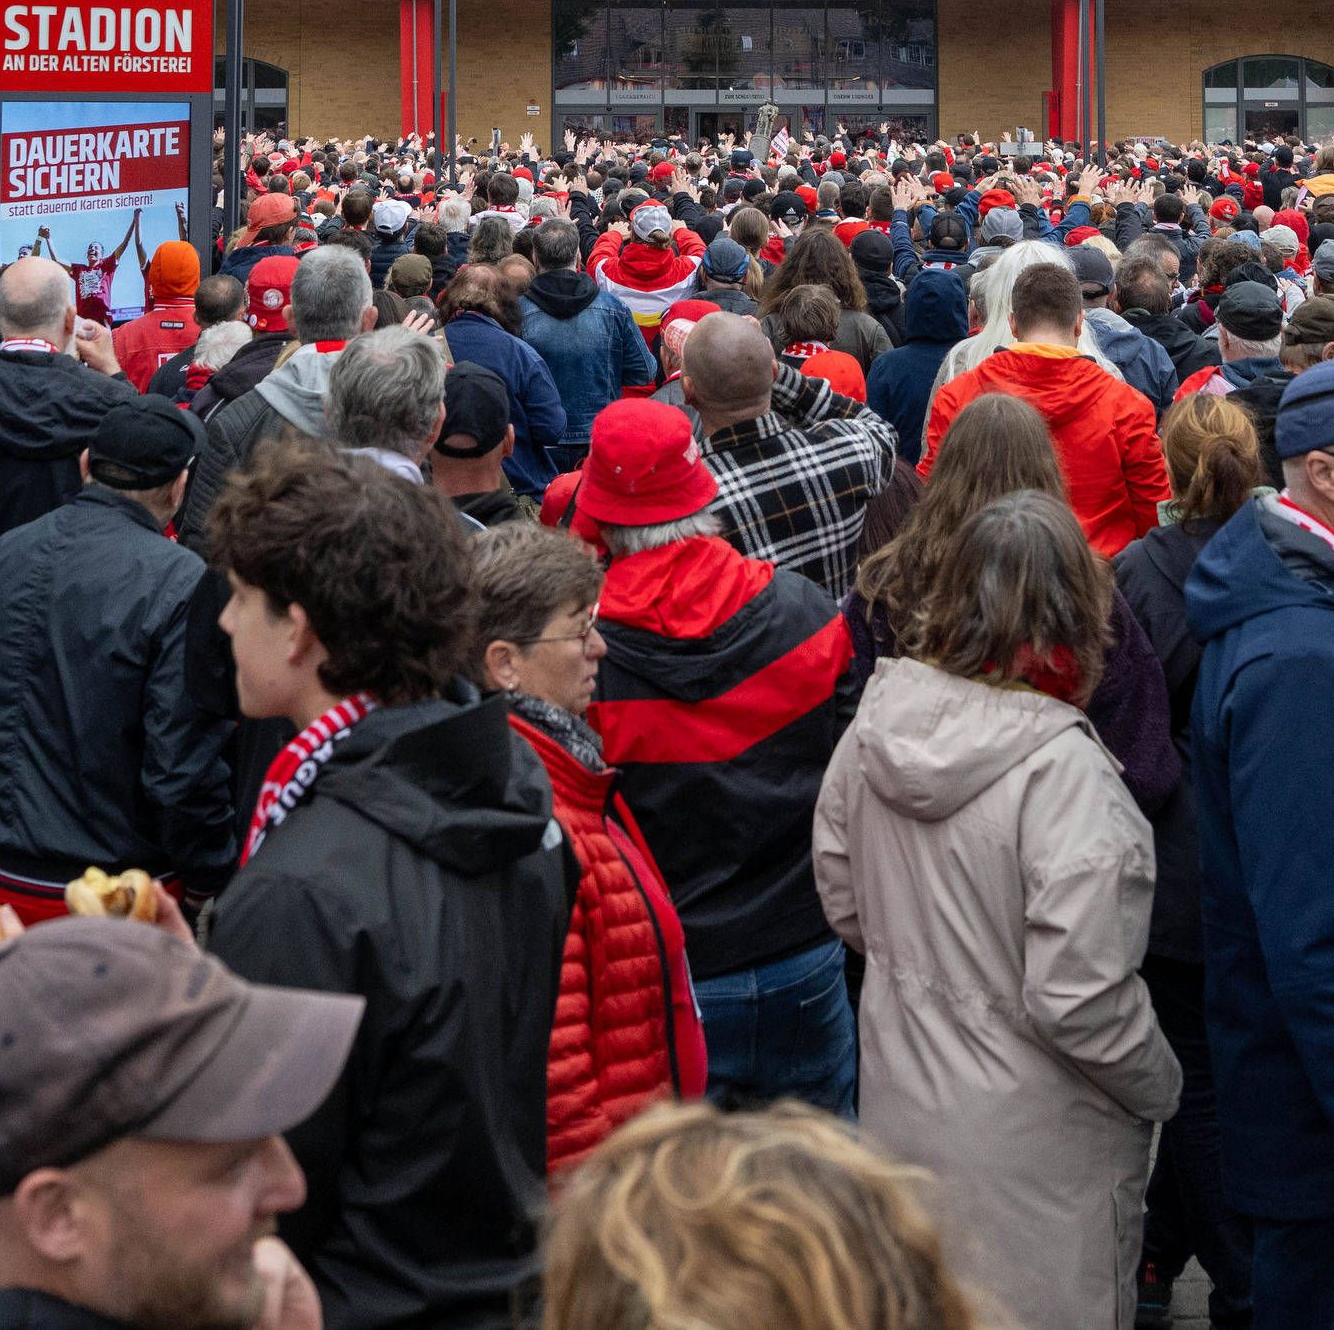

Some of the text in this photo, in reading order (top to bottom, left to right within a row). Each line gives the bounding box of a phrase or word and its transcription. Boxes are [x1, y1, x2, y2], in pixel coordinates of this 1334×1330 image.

[4, 5, 193, 53] STADION
[2, 52, 192, 73] AN DER ALTEN FÖRSTEREI
[8, 127, 181, 168] DAUERKARTE
[8, 160, 121, 198] SICHERN
[8, 193, 154, 217] statt dauernd Karten sichern!
